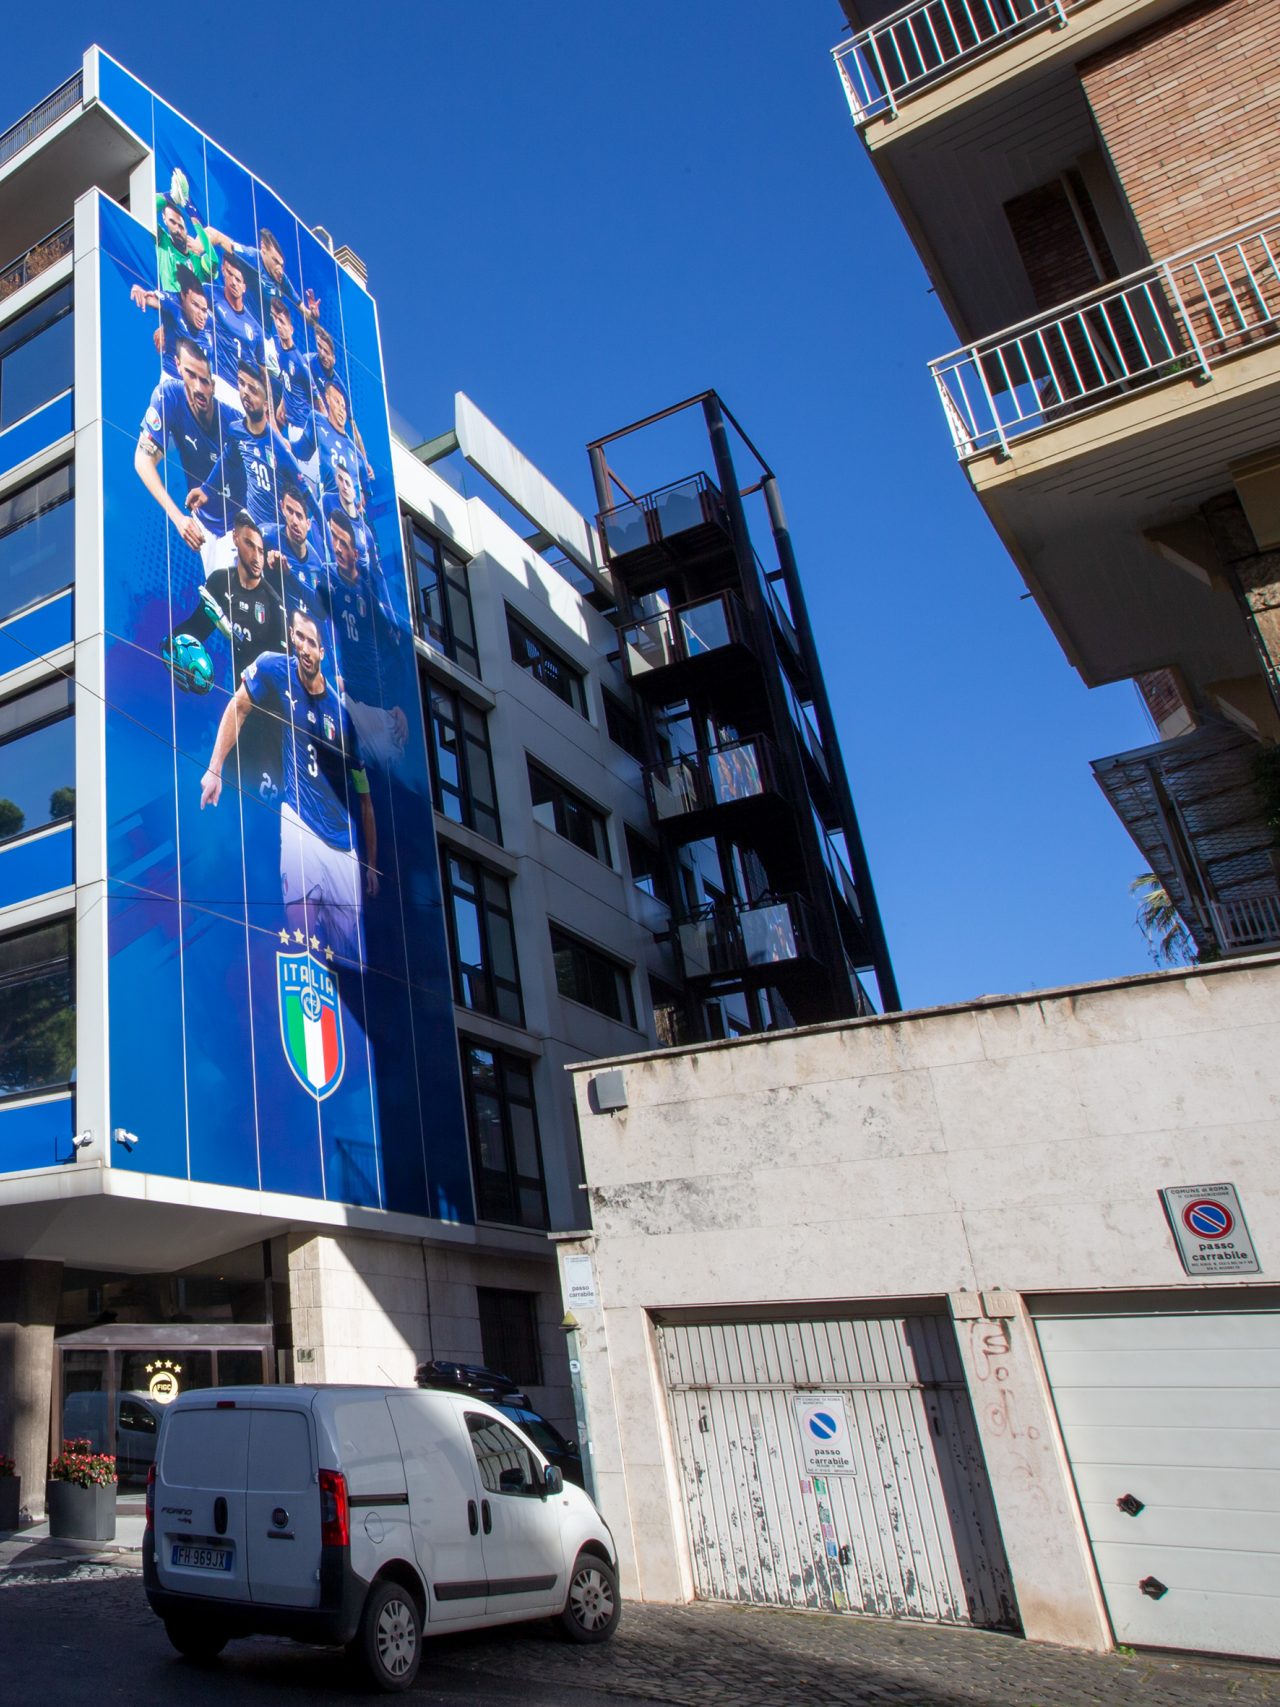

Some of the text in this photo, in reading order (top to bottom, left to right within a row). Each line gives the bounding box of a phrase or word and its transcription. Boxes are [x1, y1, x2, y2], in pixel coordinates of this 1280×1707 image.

[250, 460, 271, 492] 10
[307, 743, 319, 778] 3
[283, 963, 334, 997] ITALIA
[1198, 1242, 1234, 1251] passo
[1192, 1251, 1248, 1261] carrabile
[157, 1383, 172, 1391] FIGC
[814, 1448, 841, 1456] passo
[809, 1457, 849, 1466] carrabile
